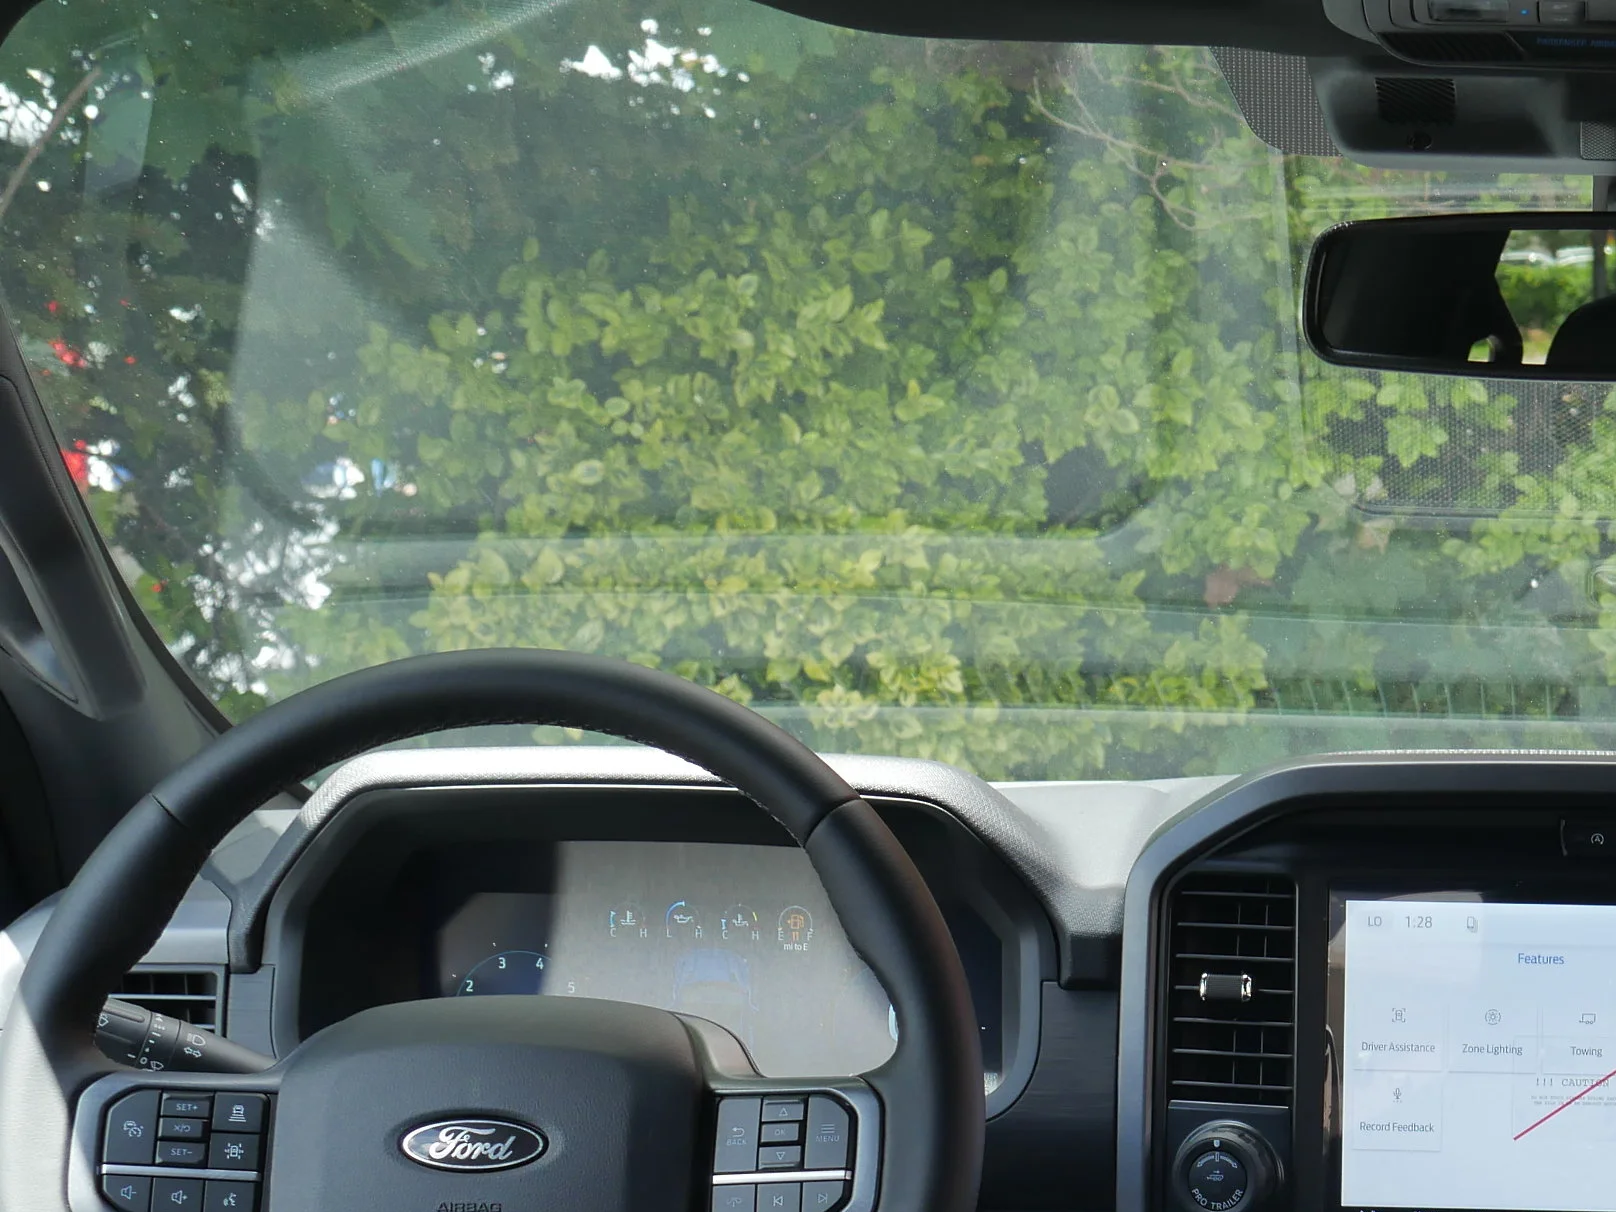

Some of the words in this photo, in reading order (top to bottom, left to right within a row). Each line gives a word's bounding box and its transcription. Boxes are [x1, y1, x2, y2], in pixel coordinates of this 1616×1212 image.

[1367, 916, 1382, 927] LO
[1405, 915, 1433, 929] 1:28
[498, 957, 507, 970] 3
[535, 957, 544, 970] 4
[1517, 952, 1565, 966] Features
[465, 980, 474, 993] 2
[567, 981, 576, 994] 5
[1361, 1041, 1387, 1052] Driver
[1388, 1042, 1436, 1053] Assistance
[1462, 1044, 1484, 1054] Zone
[1486, 1044, 1523, 1056] Lighting
[1570, 1046, 1603, 1058] Towing
[176, 1103, 198, 1112] SET+
[1359, 1121, 1391, 1133] Record
[1392, 1122, 1434, 1134] Feedback
[429, 1126, 516, 1160] Ford
[815, 1135, 840, 1143] MENU
[1191, 1188, 1208, 1206] PRO
[1210, 1189, 1244, 1210] TRAILER
